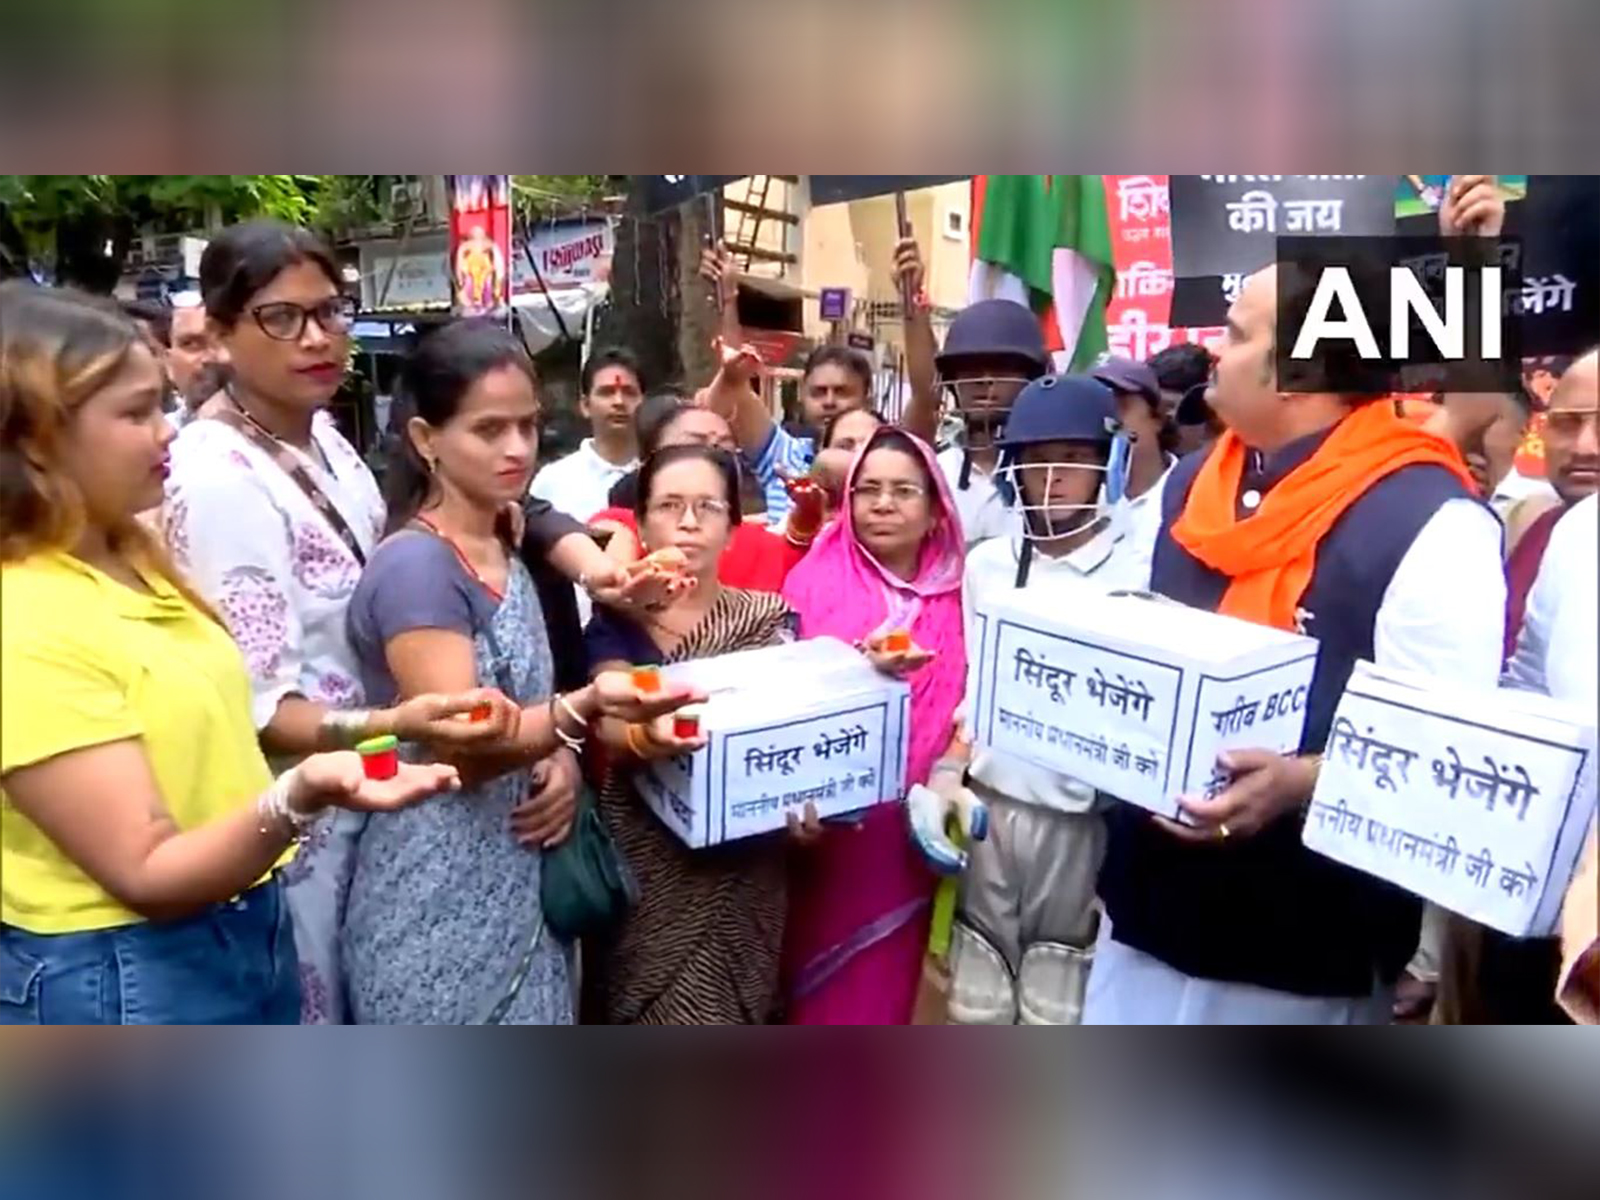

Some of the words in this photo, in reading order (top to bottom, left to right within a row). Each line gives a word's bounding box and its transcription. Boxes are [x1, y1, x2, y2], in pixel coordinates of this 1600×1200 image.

[1225, 190, 1278, 233] की
[1282, 199, 1343, 232] जय
[1013, 647, 1078, 706] सिंदूर
[1086, 667, 1156, 722] भेजेंगे
[744, 744, 805, 777] सिंदूर
[812, 724, 869, 759] भेजेंगे
[1134, 749, 1159, 781] को
[1327, 717, 1419, 793] सिंदूर
[1431, 746, 1541, 821] भेजेंगे
[1312, 799, 1364, 837] ननीय
[1464, 847, 1495, 888] जी
[1499, 860, 1538, 898] को
